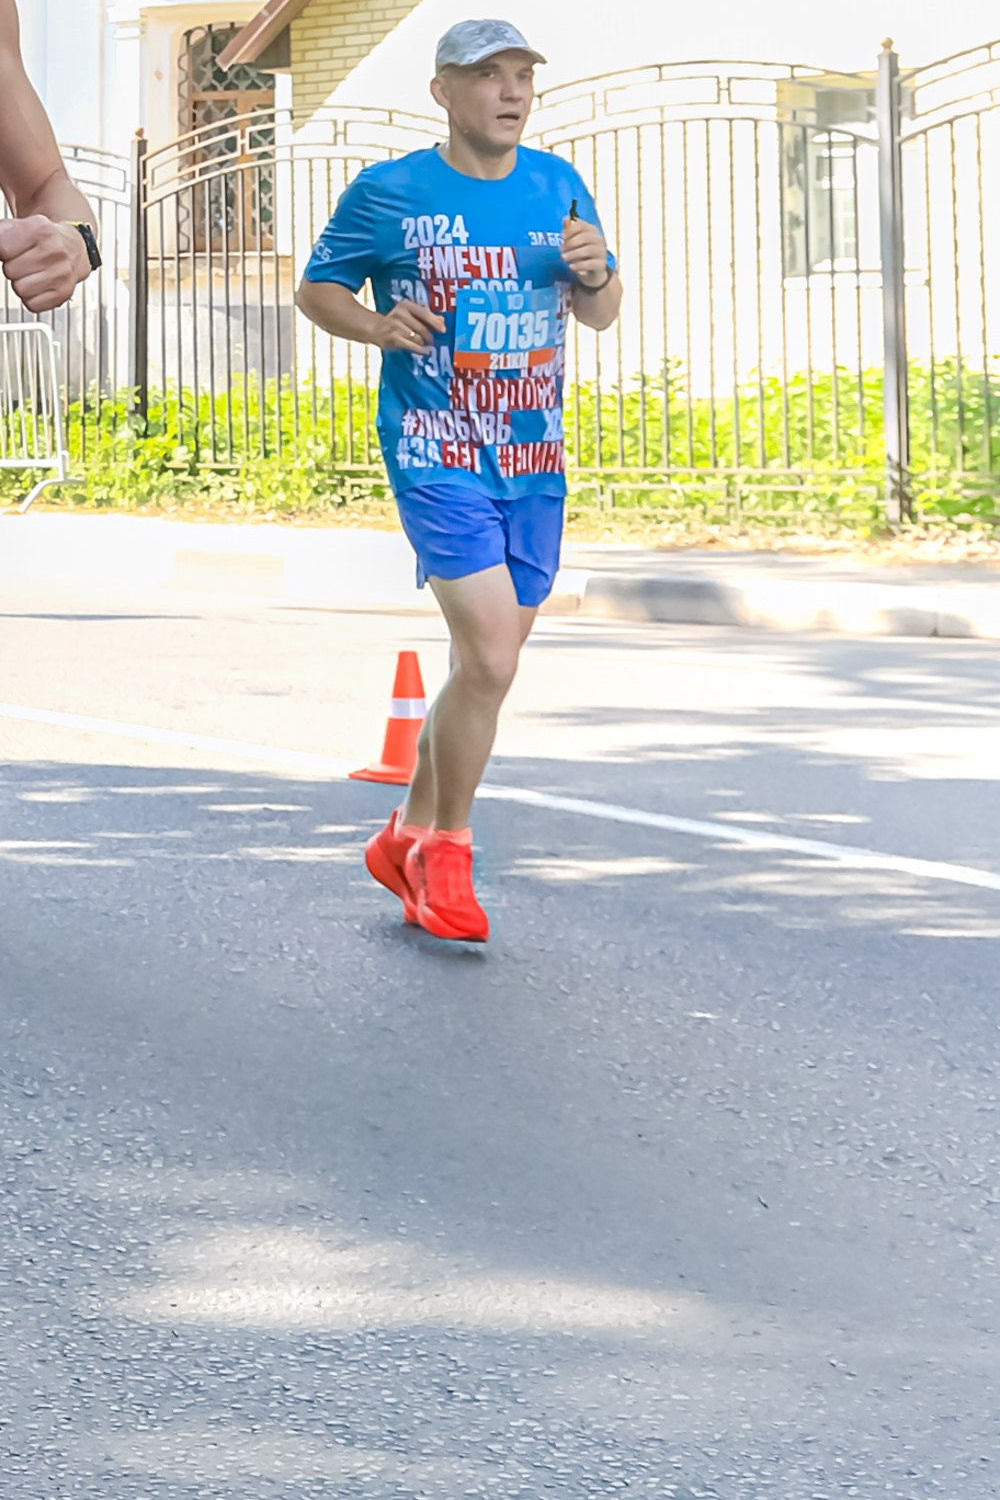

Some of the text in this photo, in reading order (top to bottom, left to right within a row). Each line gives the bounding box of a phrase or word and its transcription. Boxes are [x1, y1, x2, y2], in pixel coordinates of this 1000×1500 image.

[401, 214, 470, 250] 2024
[417, 246, 519, 279] #МЕЧТА
[467, 310, 549, 350] 70135
[401, 408, 511, 446] #ЛЮБОВЬ
